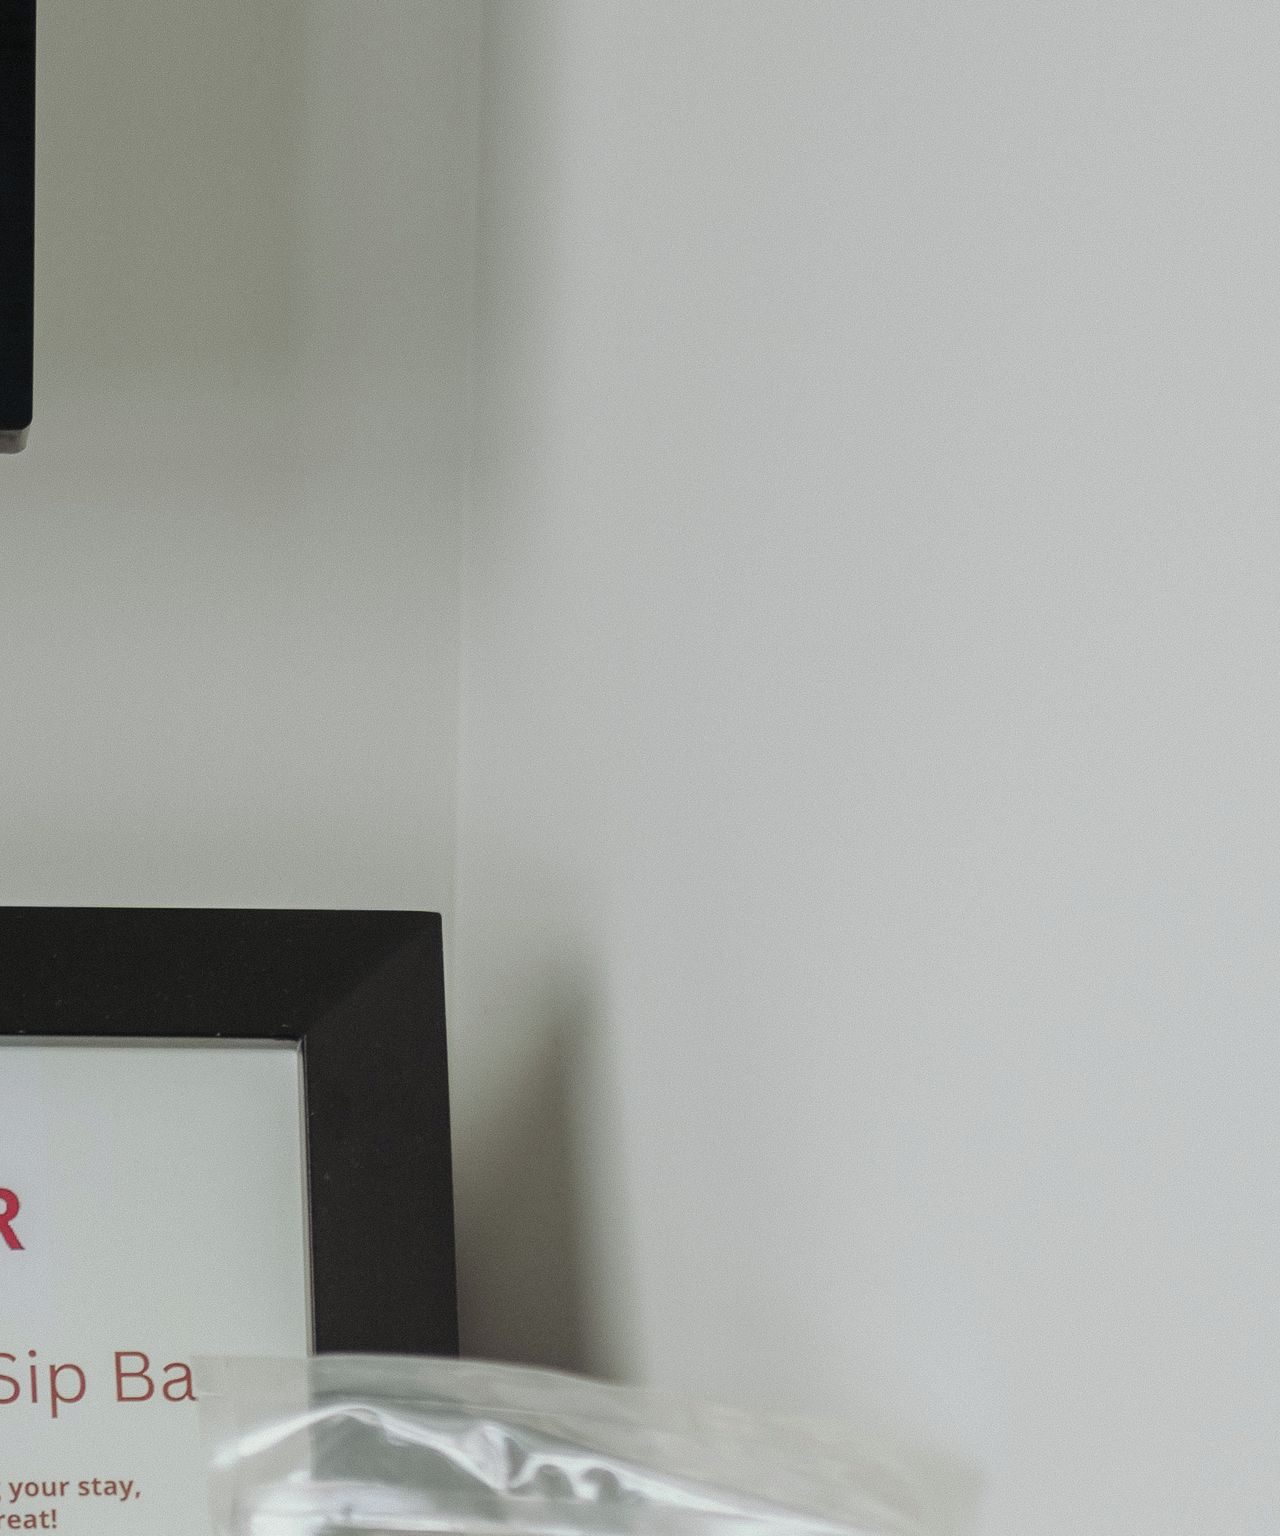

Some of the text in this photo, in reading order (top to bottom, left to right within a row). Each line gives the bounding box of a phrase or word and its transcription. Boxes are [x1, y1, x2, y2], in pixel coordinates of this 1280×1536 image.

[113, 1350, 198, 1403] Ba
[7, 1480, 71, 1505] your
[77, 1477, 142, 1503] stay,
